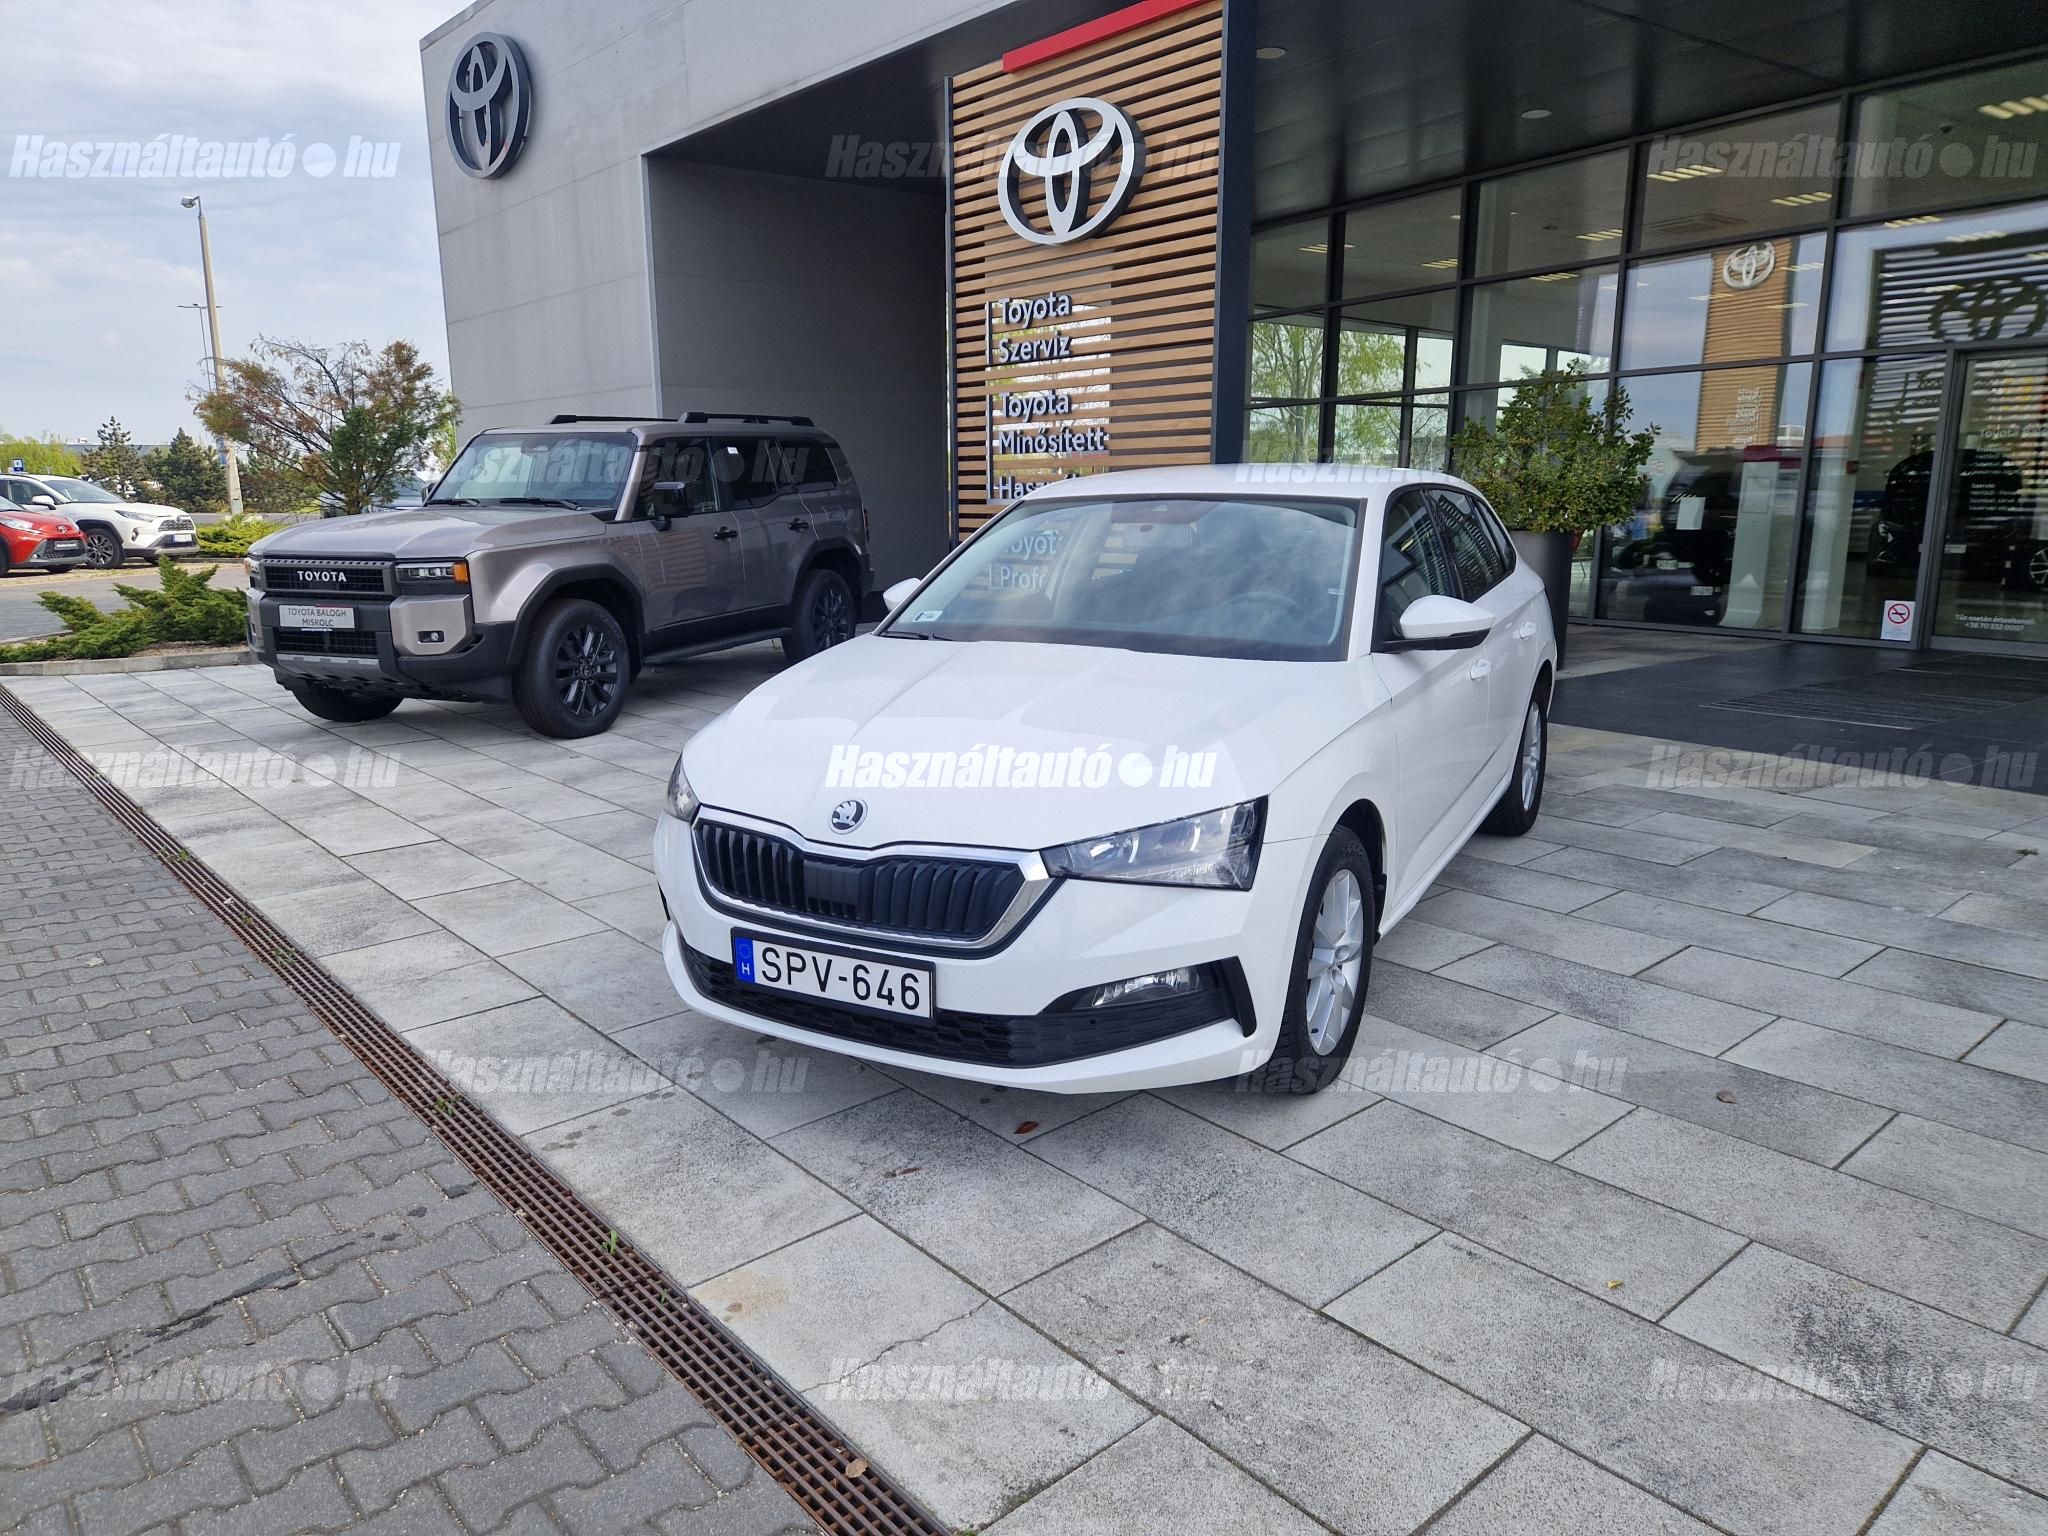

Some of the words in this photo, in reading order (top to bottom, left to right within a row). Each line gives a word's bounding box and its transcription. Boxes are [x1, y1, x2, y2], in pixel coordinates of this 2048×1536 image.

[998, 292, 1071, 328] Toyota
[998, 331, 1071, 363] Szerviz
[999, 390, 1070, 422] Toyota
[999, 426, 1105, 455] Minősített
[296, 570, 347, 582] TOYOTA
[288, 608, 315, 617] TOYOTA
[316, 609, 347, 617] BALOGH
[302, 618, 334, 627] MISKOLC
[741, 961, 750, 976] H
[761, 946, 920, 1011] SPV-646
